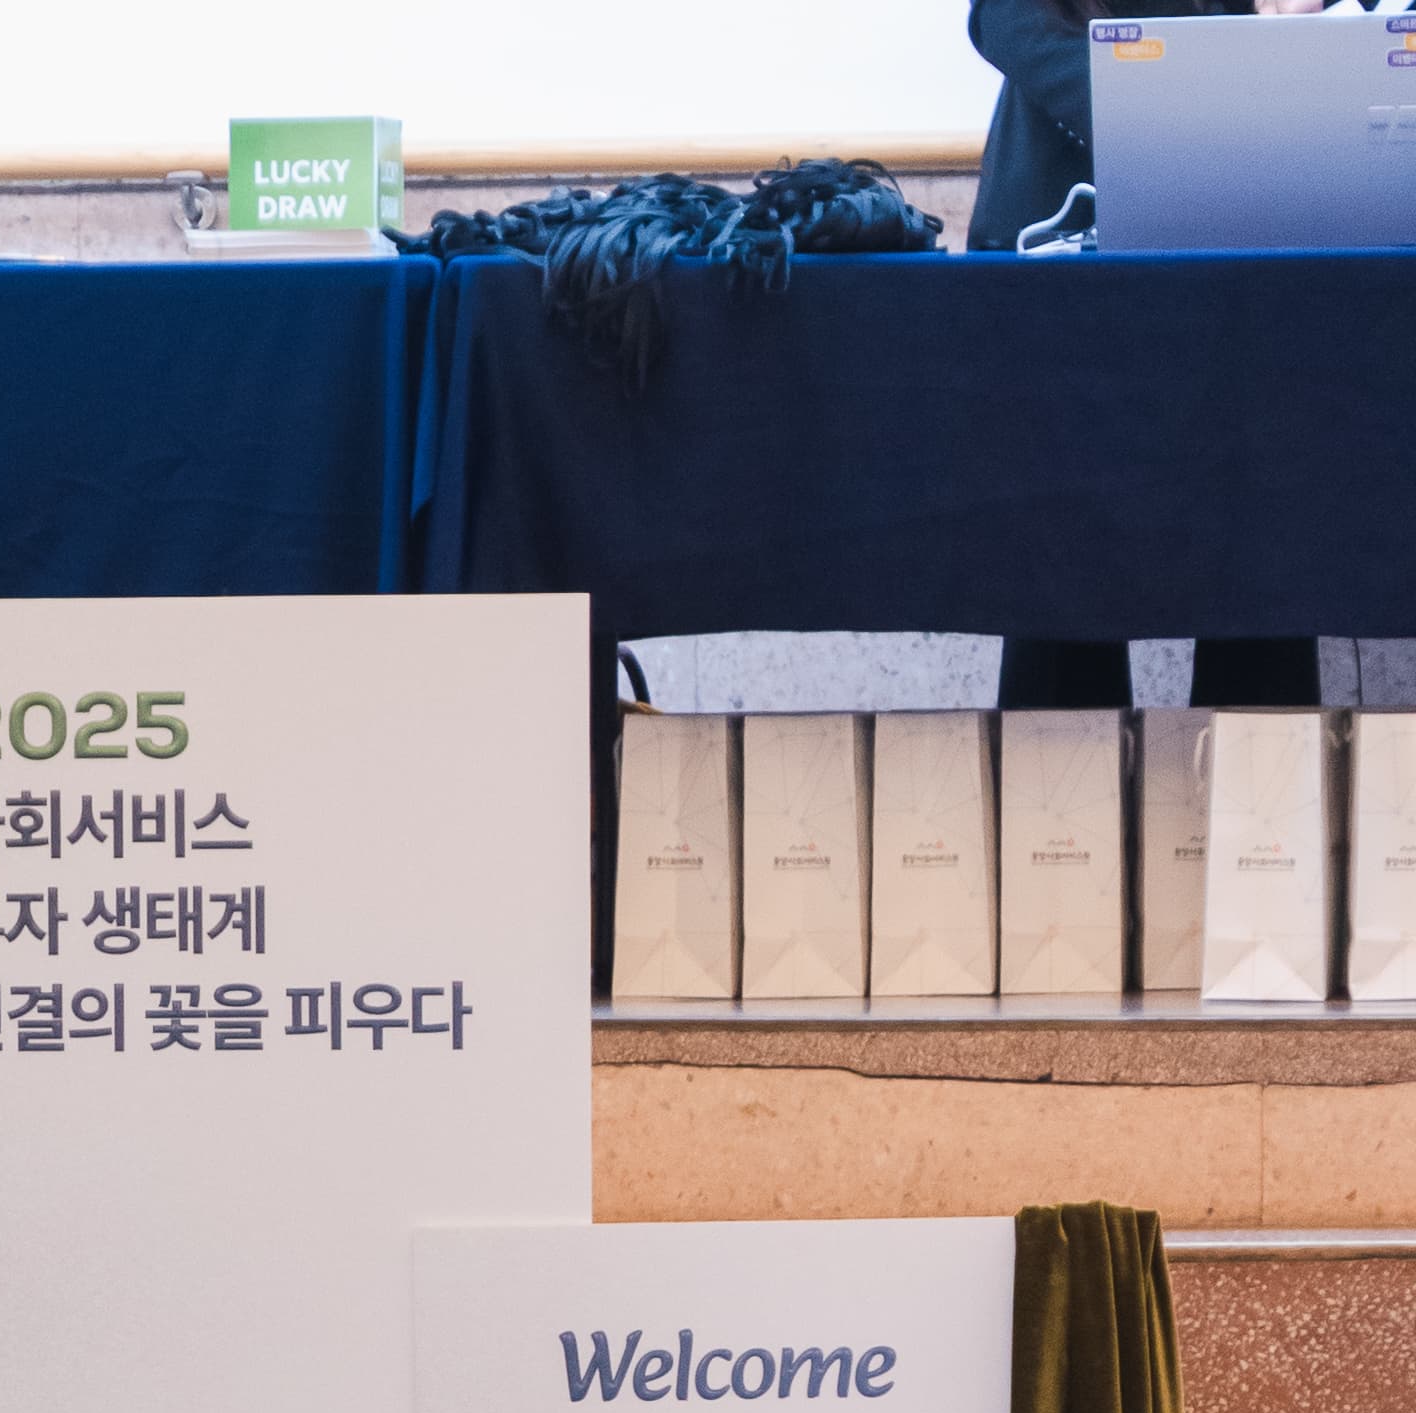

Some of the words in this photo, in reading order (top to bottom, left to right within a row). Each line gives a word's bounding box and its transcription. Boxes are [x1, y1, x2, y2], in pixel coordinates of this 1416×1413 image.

[253, 159, 351, 184] LUCKY
[257, 195, 347, 219] DRAW
[81, 885, 267, 956] 생태계
[144, 983, 270, 1052] 꽃을
[284, 980, 474, 1051] 피우다
[558, 1328, 898, 1403] Welcome
